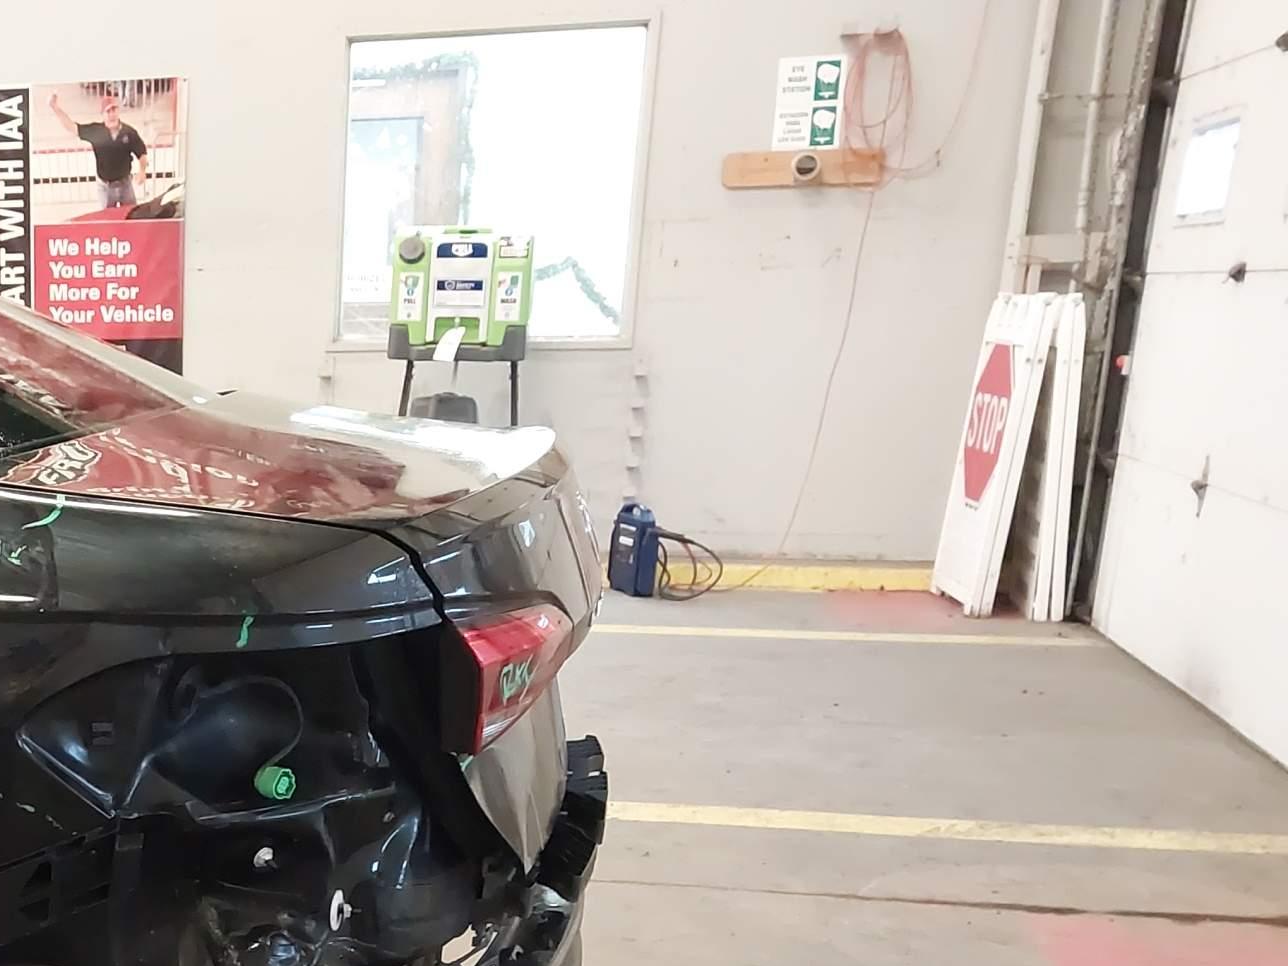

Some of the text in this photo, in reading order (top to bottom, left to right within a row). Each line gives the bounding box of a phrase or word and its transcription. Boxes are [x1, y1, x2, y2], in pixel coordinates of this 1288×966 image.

[48, 237, 131, 259] We Help
[49, 260, 137, 279] You Earn
[49, 284, 140, 301] More For
[49, 304, 174, 323] Your Vehicle
[967, 391, 1008, 455] STOP
